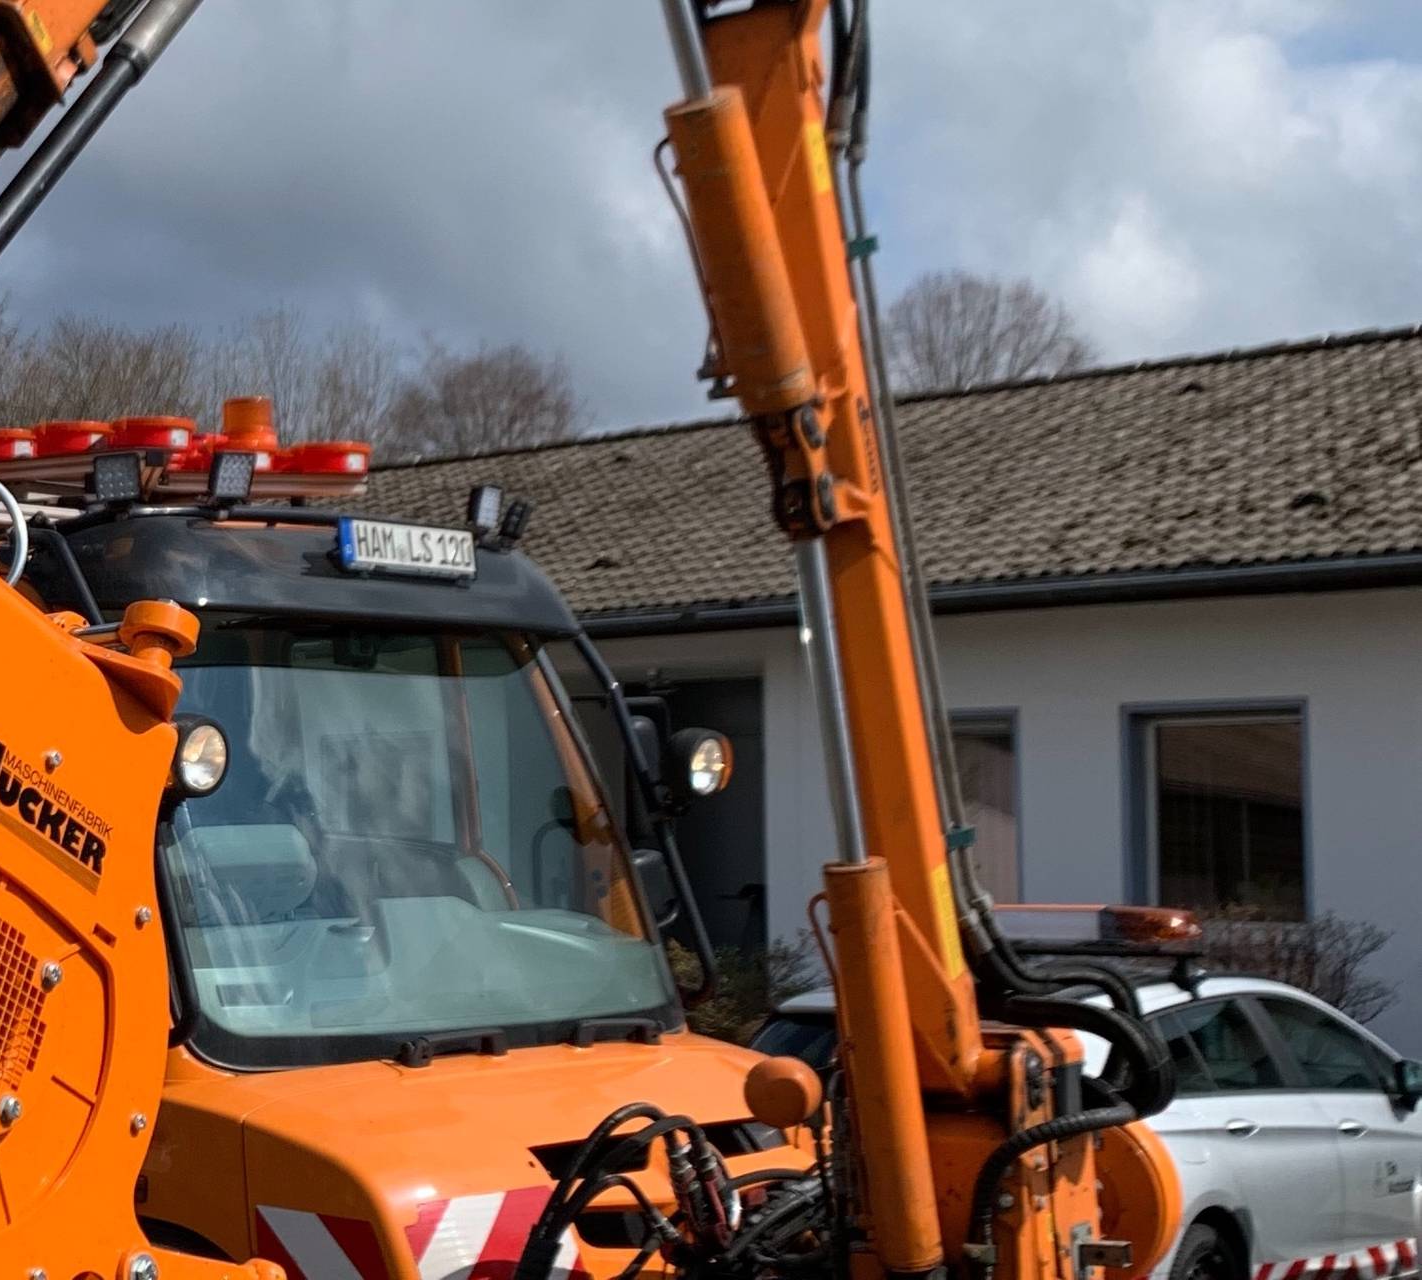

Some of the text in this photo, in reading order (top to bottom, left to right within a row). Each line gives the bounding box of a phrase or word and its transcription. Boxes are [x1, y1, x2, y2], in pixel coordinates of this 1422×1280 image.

[355, 523, 472, 567] HAM LS 120
[3, 750, 113, 840] MASCHINENFABRIK
